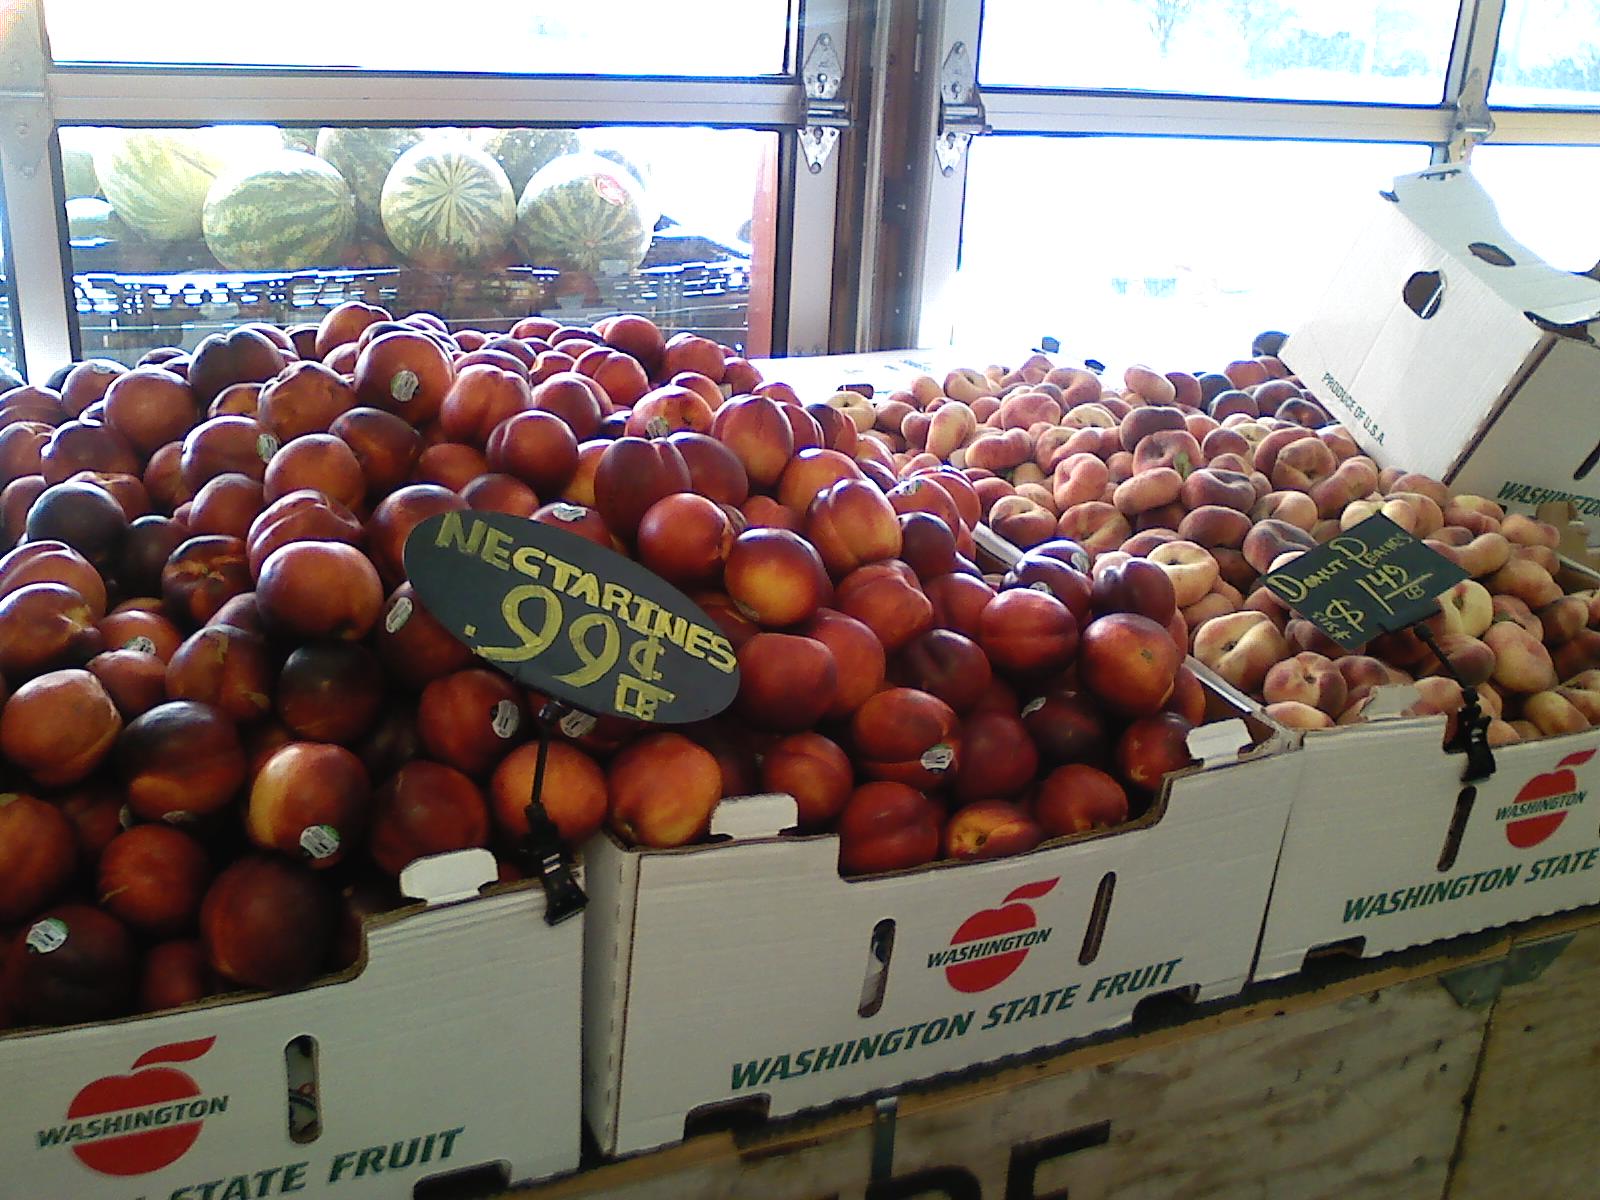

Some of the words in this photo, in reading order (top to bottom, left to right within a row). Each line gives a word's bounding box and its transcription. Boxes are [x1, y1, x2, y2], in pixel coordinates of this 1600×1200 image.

[1321, 371, 1356, 412] PRODUCE
[1353, 405, 1366, 419] OF
[434, 511, 738, 674] NECTARINES
[1495, 791, 1589, 821] WASHINGTON
[1342, 863, 1523, 924] WASHINGTON
[1524, 847, 1600, 884] STATE
[927, 927, 1052, 969] WASHINGTON
[731, 1010, 976, 1090] WASHINGTON
[980, 984, 1082, 1029] STATE
[1086, 957, 1183, 1003] FRUIT
[37, 1096, 229, 1149] WASHINGTON
[327, 1126, 466, 1185] FRUIT
